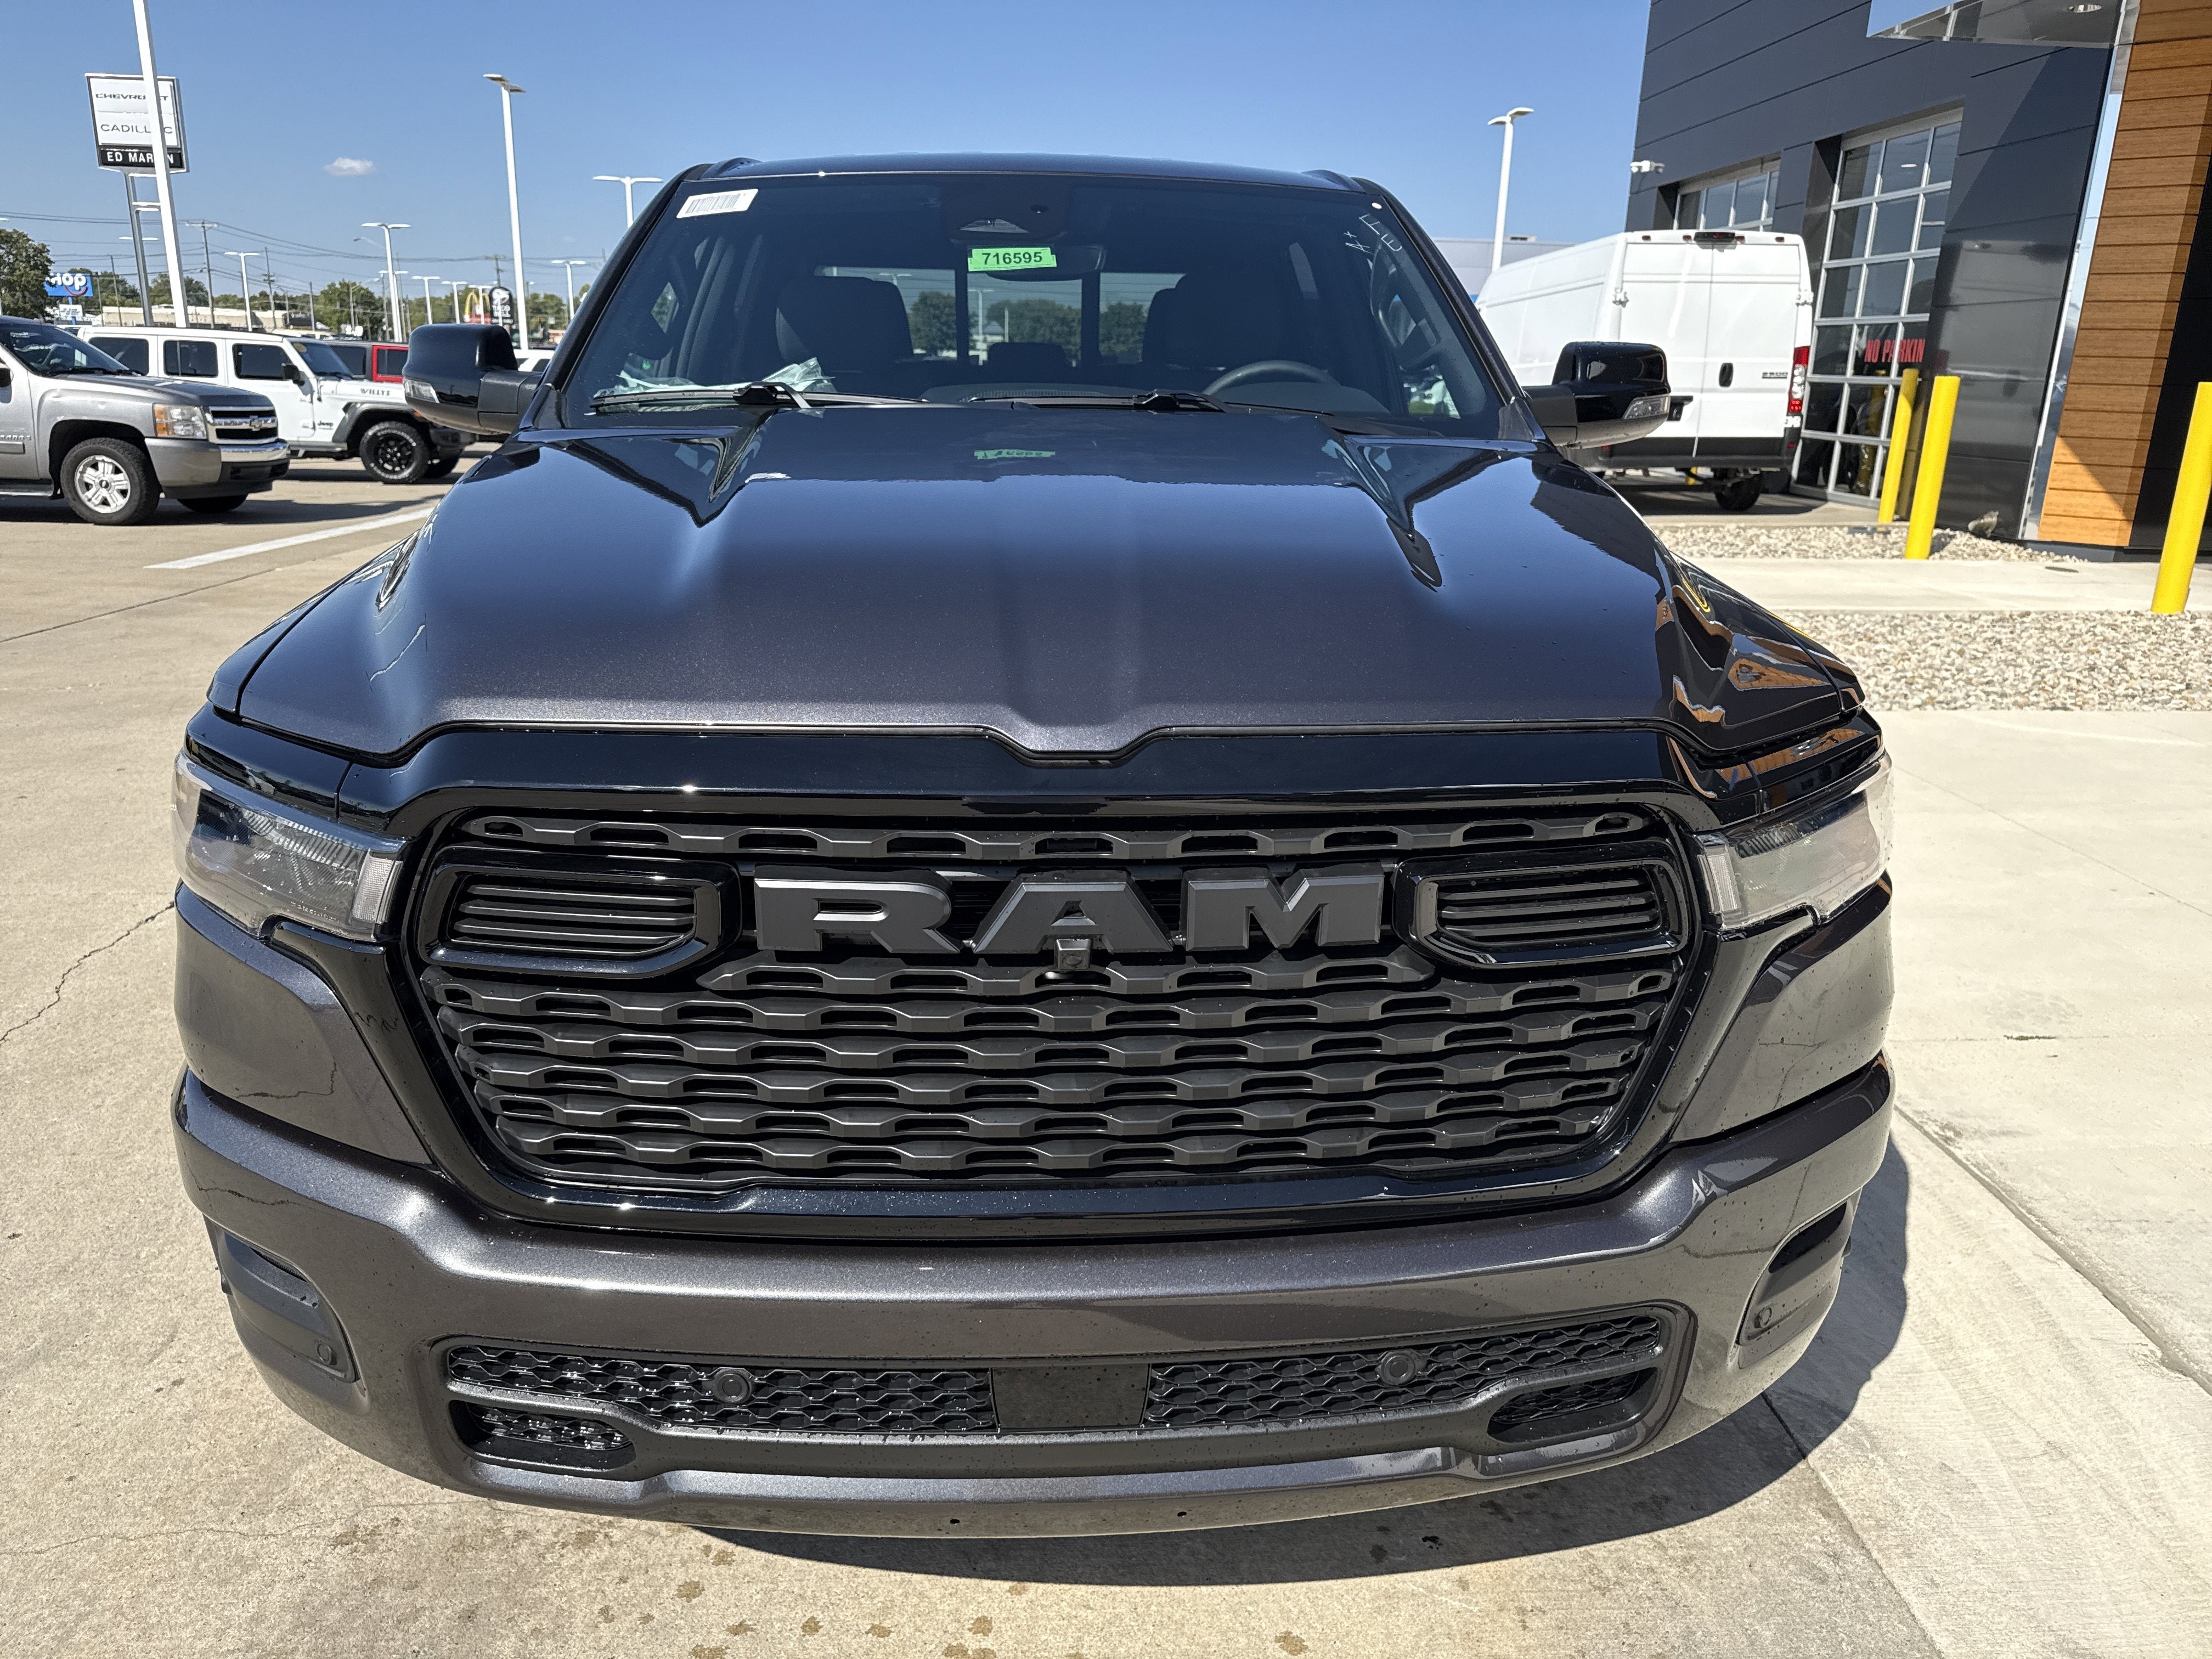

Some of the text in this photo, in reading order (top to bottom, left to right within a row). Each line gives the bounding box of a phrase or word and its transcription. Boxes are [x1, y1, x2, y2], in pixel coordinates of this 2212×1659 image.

[100, 124, 173, 134] CADILLC
[106, 151, 174, 164] ED MARN
[981, 251, 1043, 265] 716595
[1864, 338, 1926, 363] NO PARKIN
[755, 872, 1384, 954] RAM
